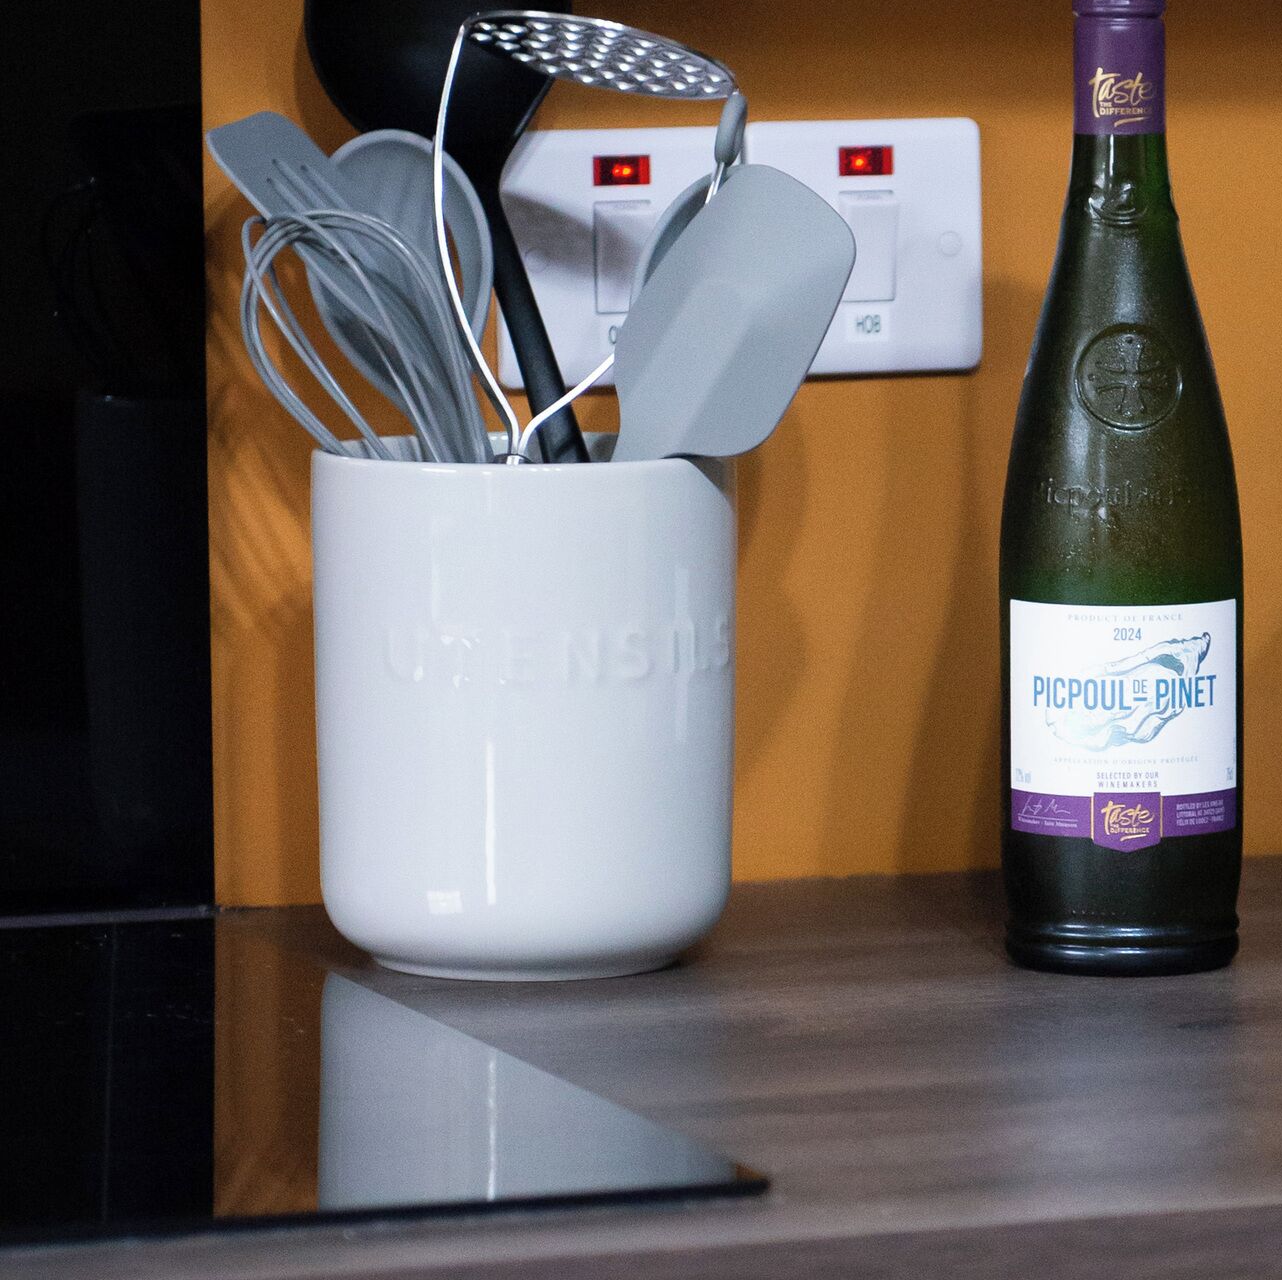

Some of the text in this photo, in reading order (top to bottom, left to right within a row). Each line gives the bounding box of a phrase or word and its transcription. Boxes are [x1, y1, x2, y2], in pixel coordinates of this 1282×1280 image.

[856, 314, 881, 334] HOB
[1113, 627, 1142, 641] 2024
[1033, 674, 1217, 711] PICPOUL DE PINET
[1096, 771, 1159, 780] SELECTED BY OUR
[1097, 780, 1158, 789] WINEMAKERS
